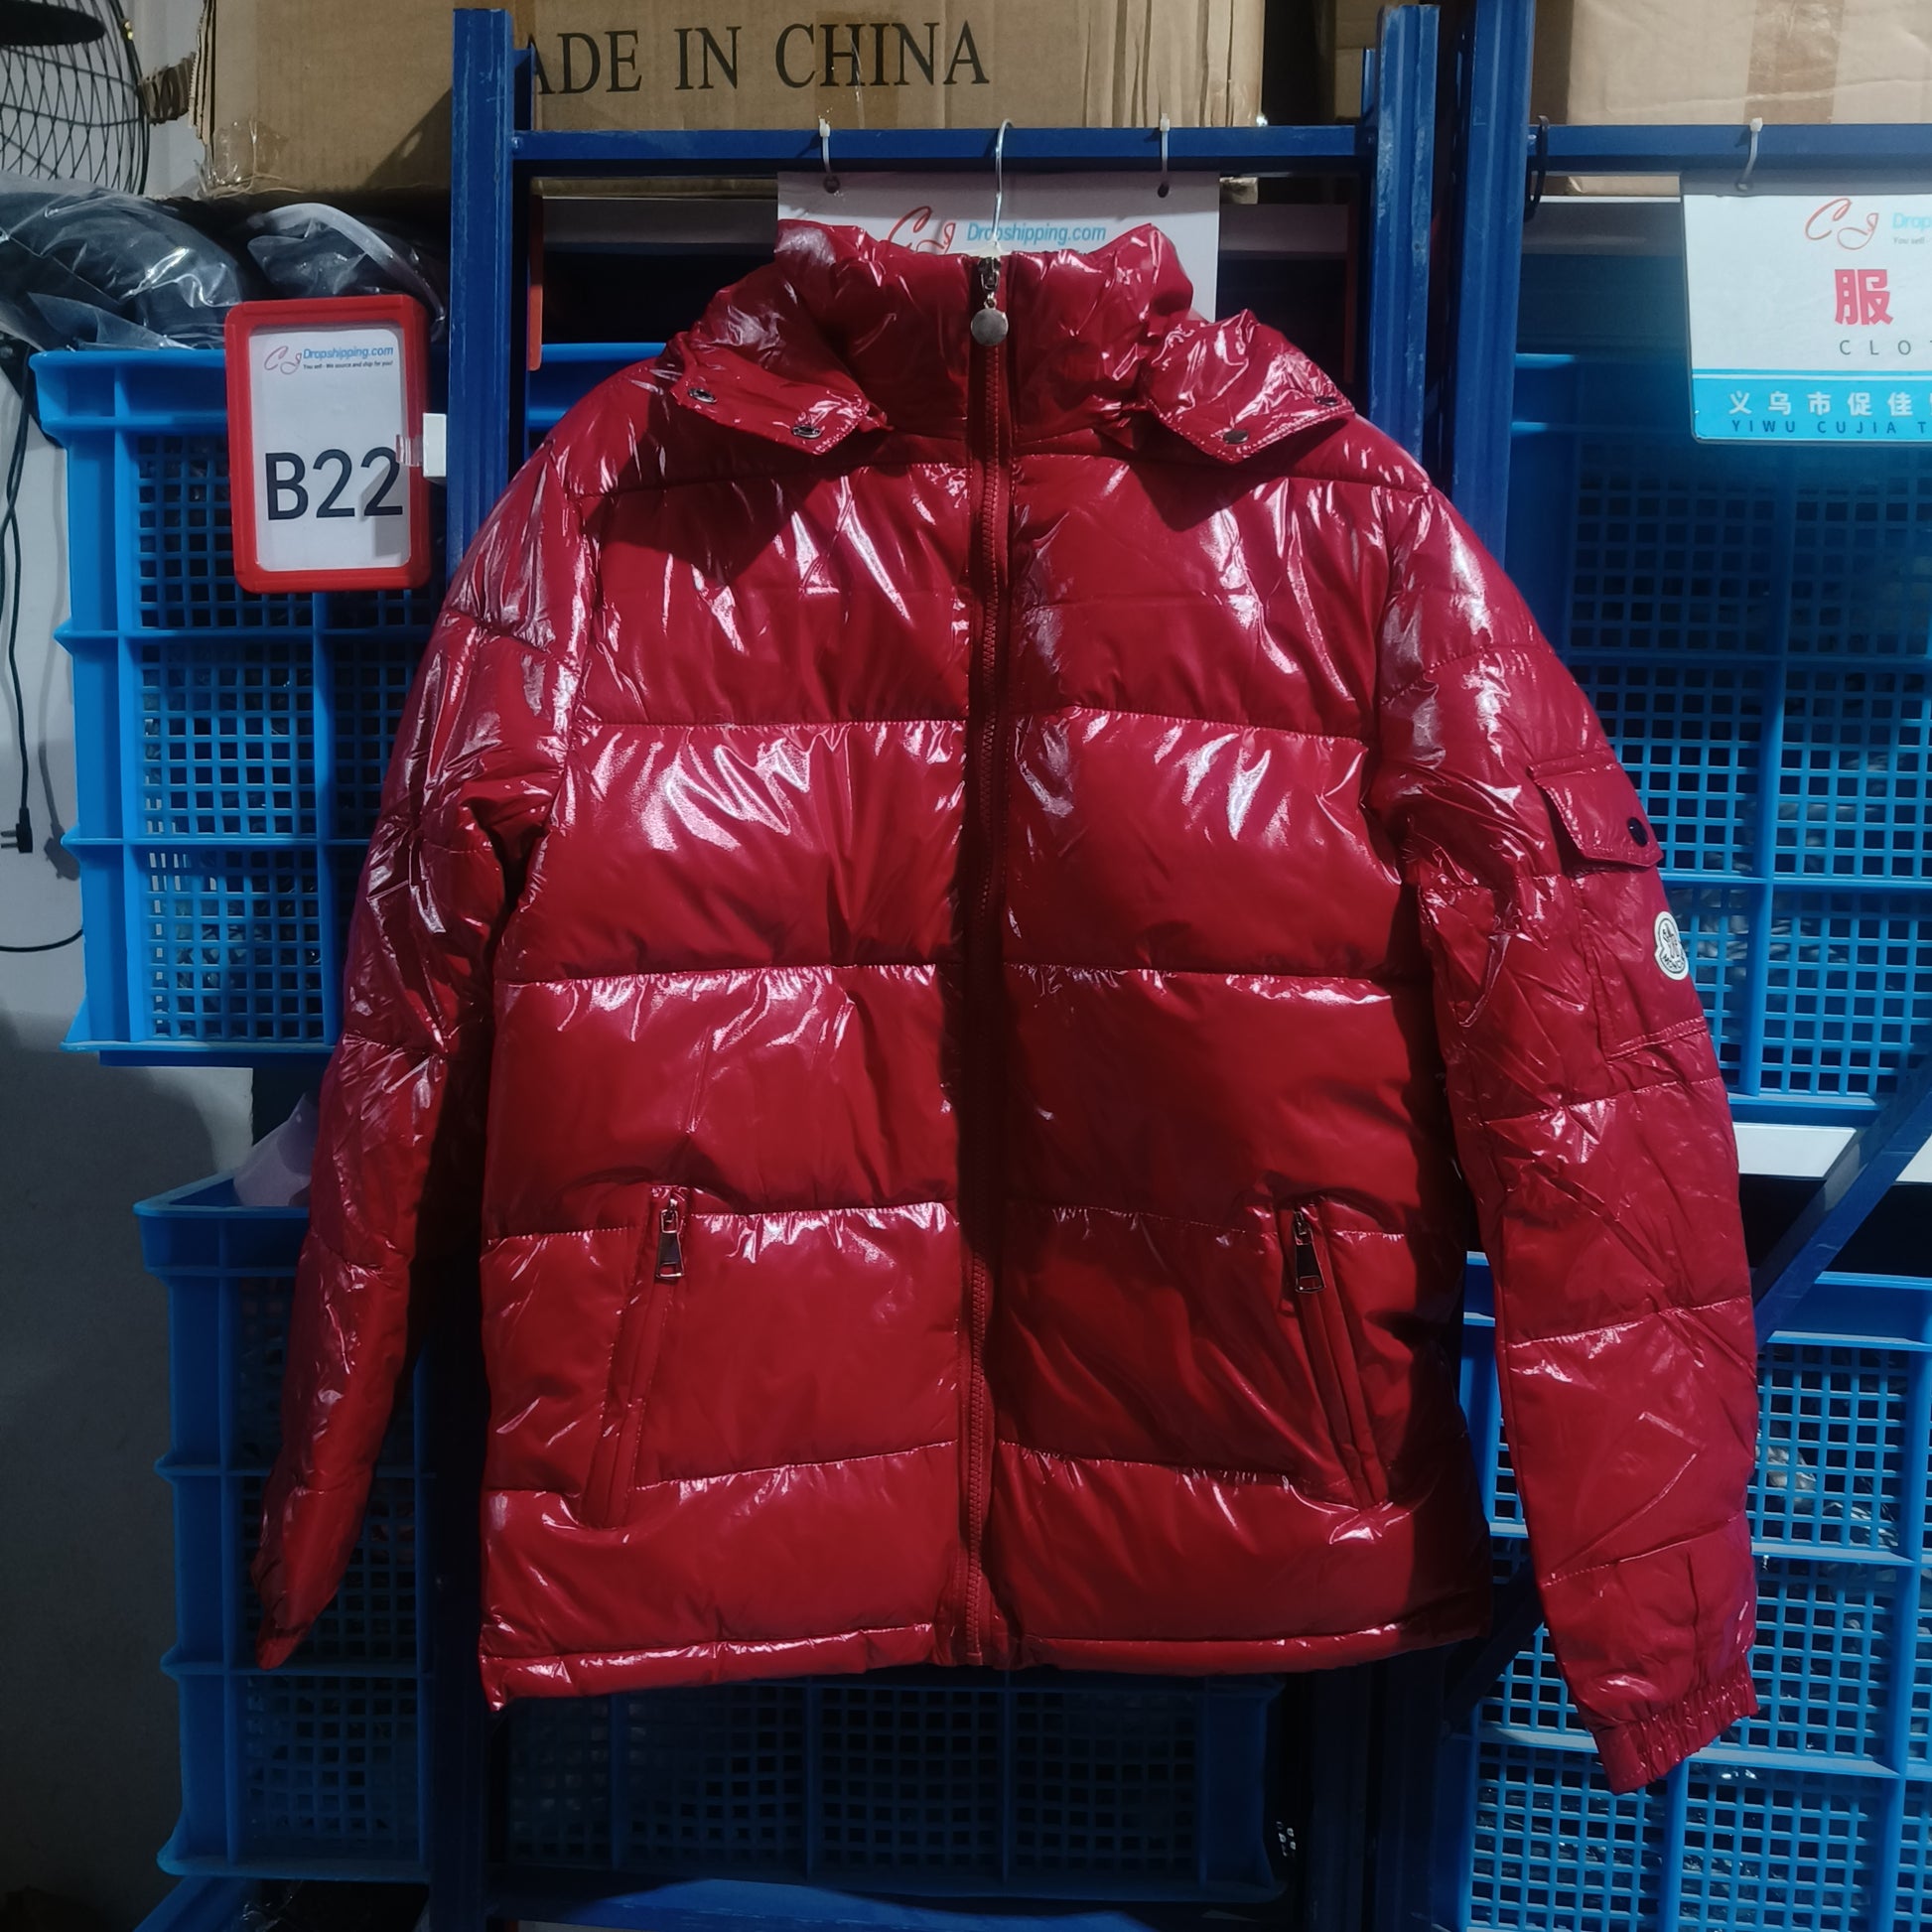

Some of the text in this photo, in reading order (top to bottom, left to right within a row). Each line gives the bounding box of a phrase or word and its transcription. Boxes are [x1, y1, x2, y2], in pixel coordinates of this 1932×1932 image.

[673, 26, 743, 90] IN
[774, 20, 990, 88] CHINA
[967, 221, 1107, 246] Dropshipping.com
[1892, 236, 1909, 245] You
[1834, 268, 1894, 326] 服
[303, 346, 394, 359] Dropshipping.com
[1727, 390, 1932, 417] 义乌市促佳
[1731, 419, 1796, 434] YIWU
[1817, 420, 1896, 435] CUJIA
[264, 446, 404, 521] B22
